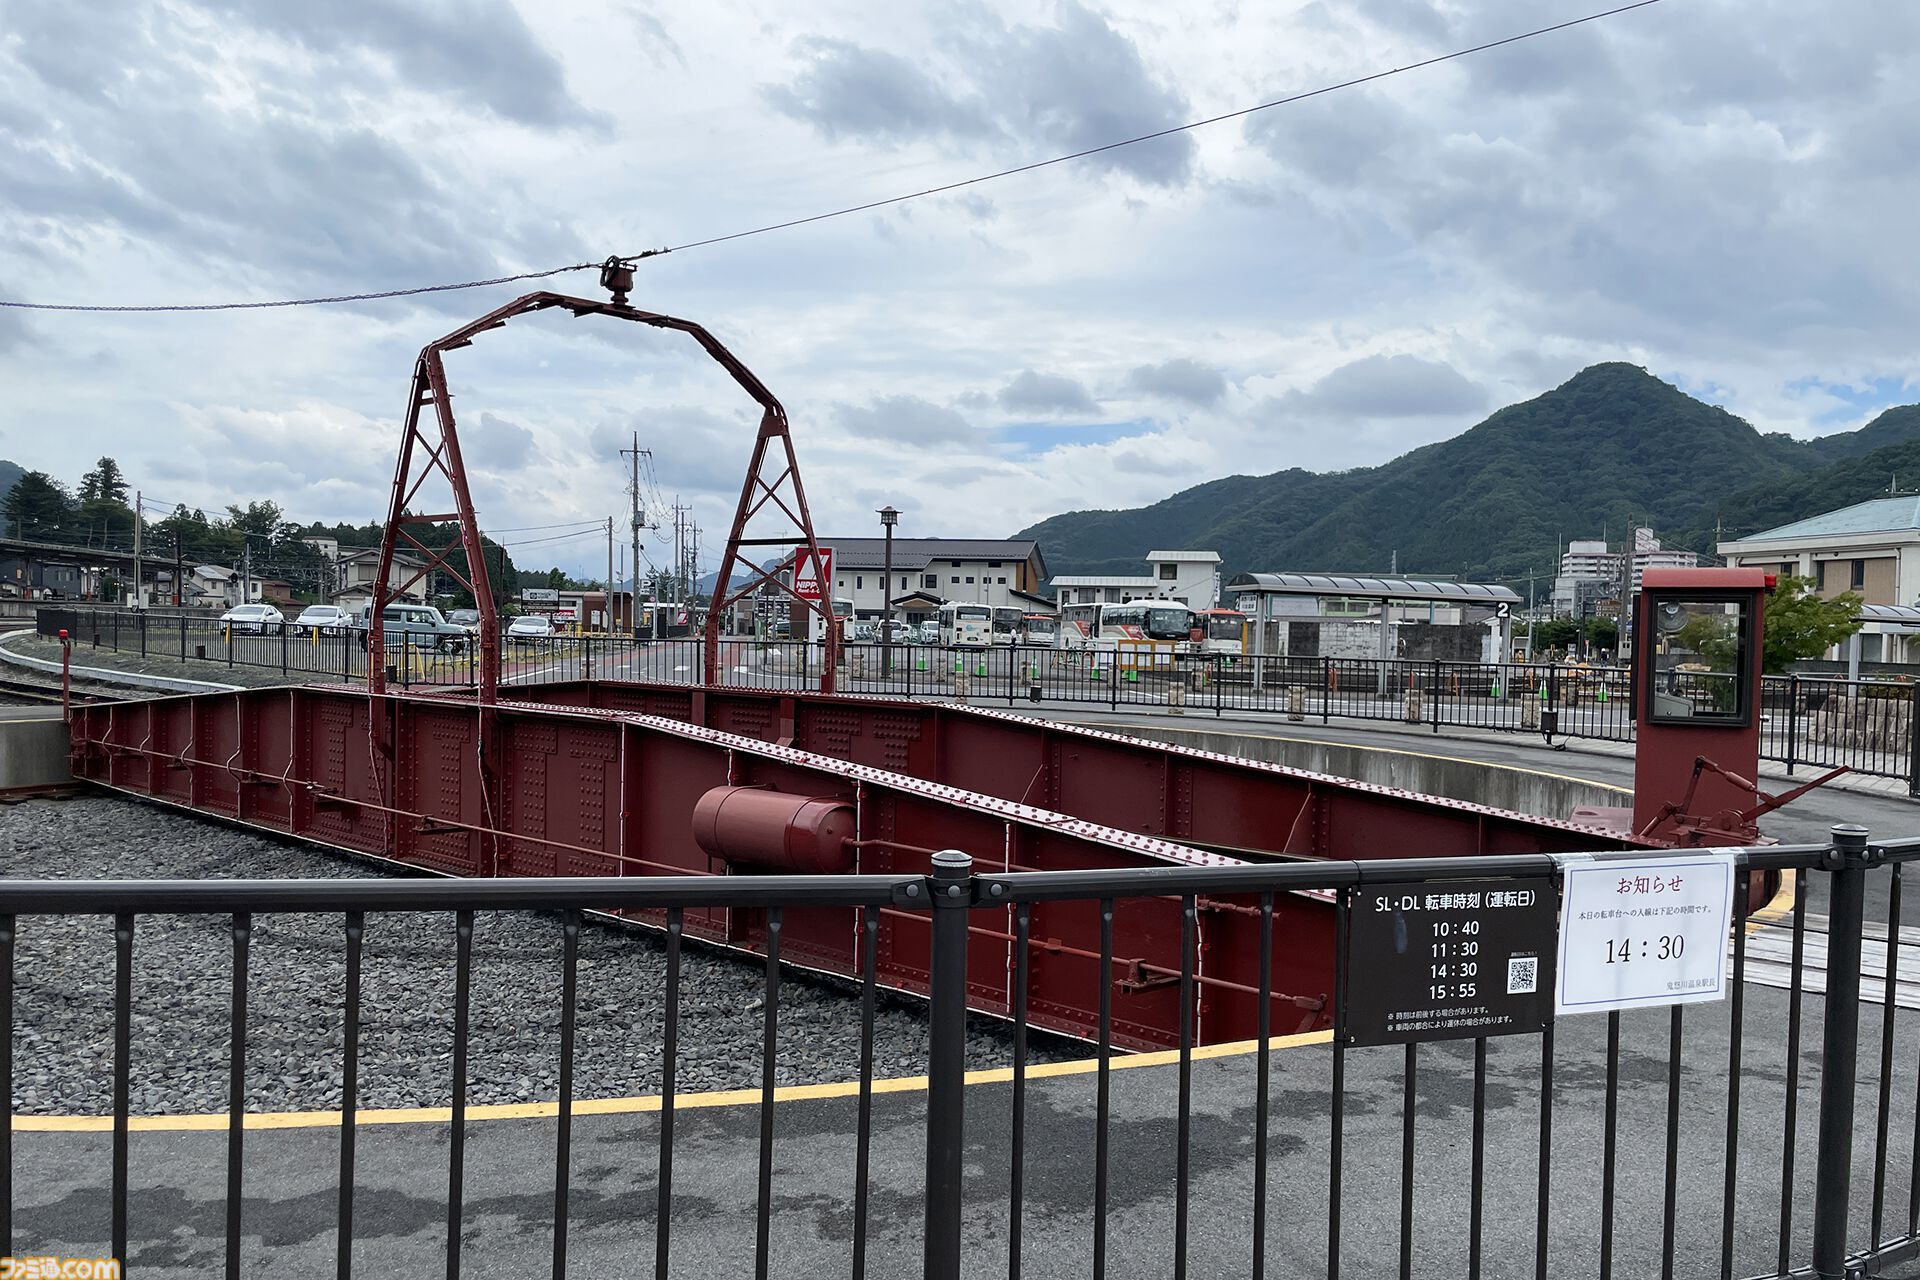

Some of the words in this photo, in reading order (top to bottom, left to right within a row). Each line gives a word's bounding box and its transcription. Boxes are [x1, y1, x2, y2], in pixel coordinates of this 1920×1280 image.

[642, 580, 651, 589] P
[1497, 602, 1509, 618] 2
[1616, 875, 1684, 895] お知らせ
